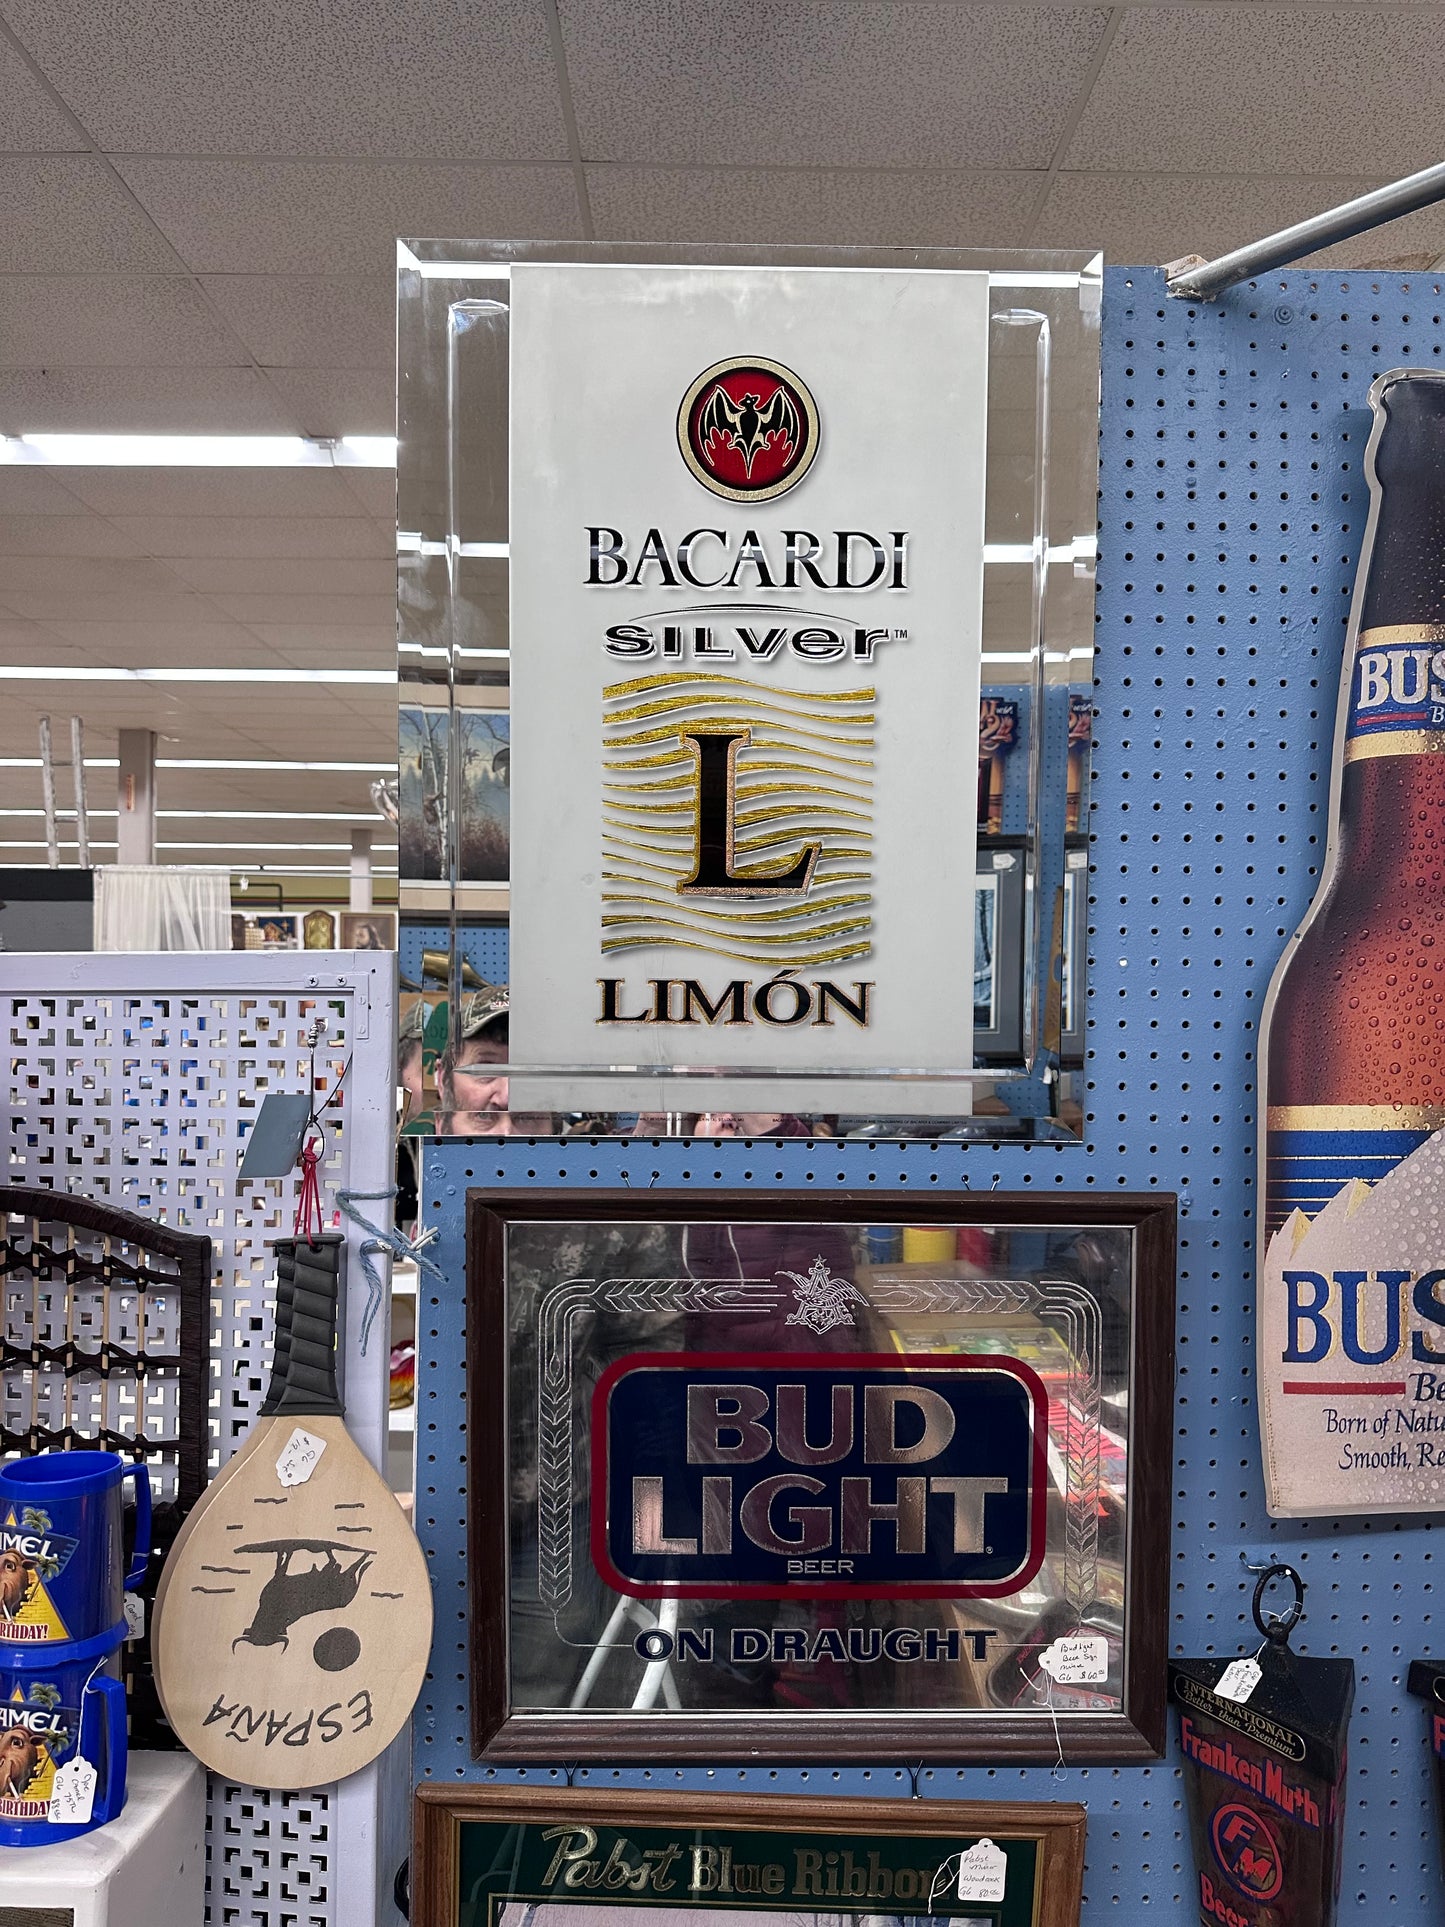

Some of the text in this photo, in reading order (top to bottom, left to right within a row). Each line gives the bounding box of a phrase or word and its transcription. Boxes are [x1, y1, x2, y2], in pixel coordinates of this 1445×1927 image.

[583, 527, 909, 589] BACARDI
[676, 727, 821, 897] L
[595, 969, 875, 1028] LIMÓN
[687, 1384, 956, 1465] BUD
[1323, 1408, 1368, 1434] Born
[1372, 1409, 1392, 1439] of
[1338, 1442, 1412, 1471] Smooth,
[632, 1474, 1009, 1555] LIGHT
[0, 1532, 58, 1560] MEL
[787, 1560, 855, 1575] BEER
[632, 1628, 715, 1664] ON
[731, 1628, 999, 1664] DRAUGHT
[202, 1689, 373, 1747] ESPAÑA
[1183, 1679, 1297, 1747] INTERNATIONAL
[1183, 1689, 1296, 1756] Better than Premium
[541, 1824, 684, 1891] Pabst
[688, 1845, 786, 1893] Blue
